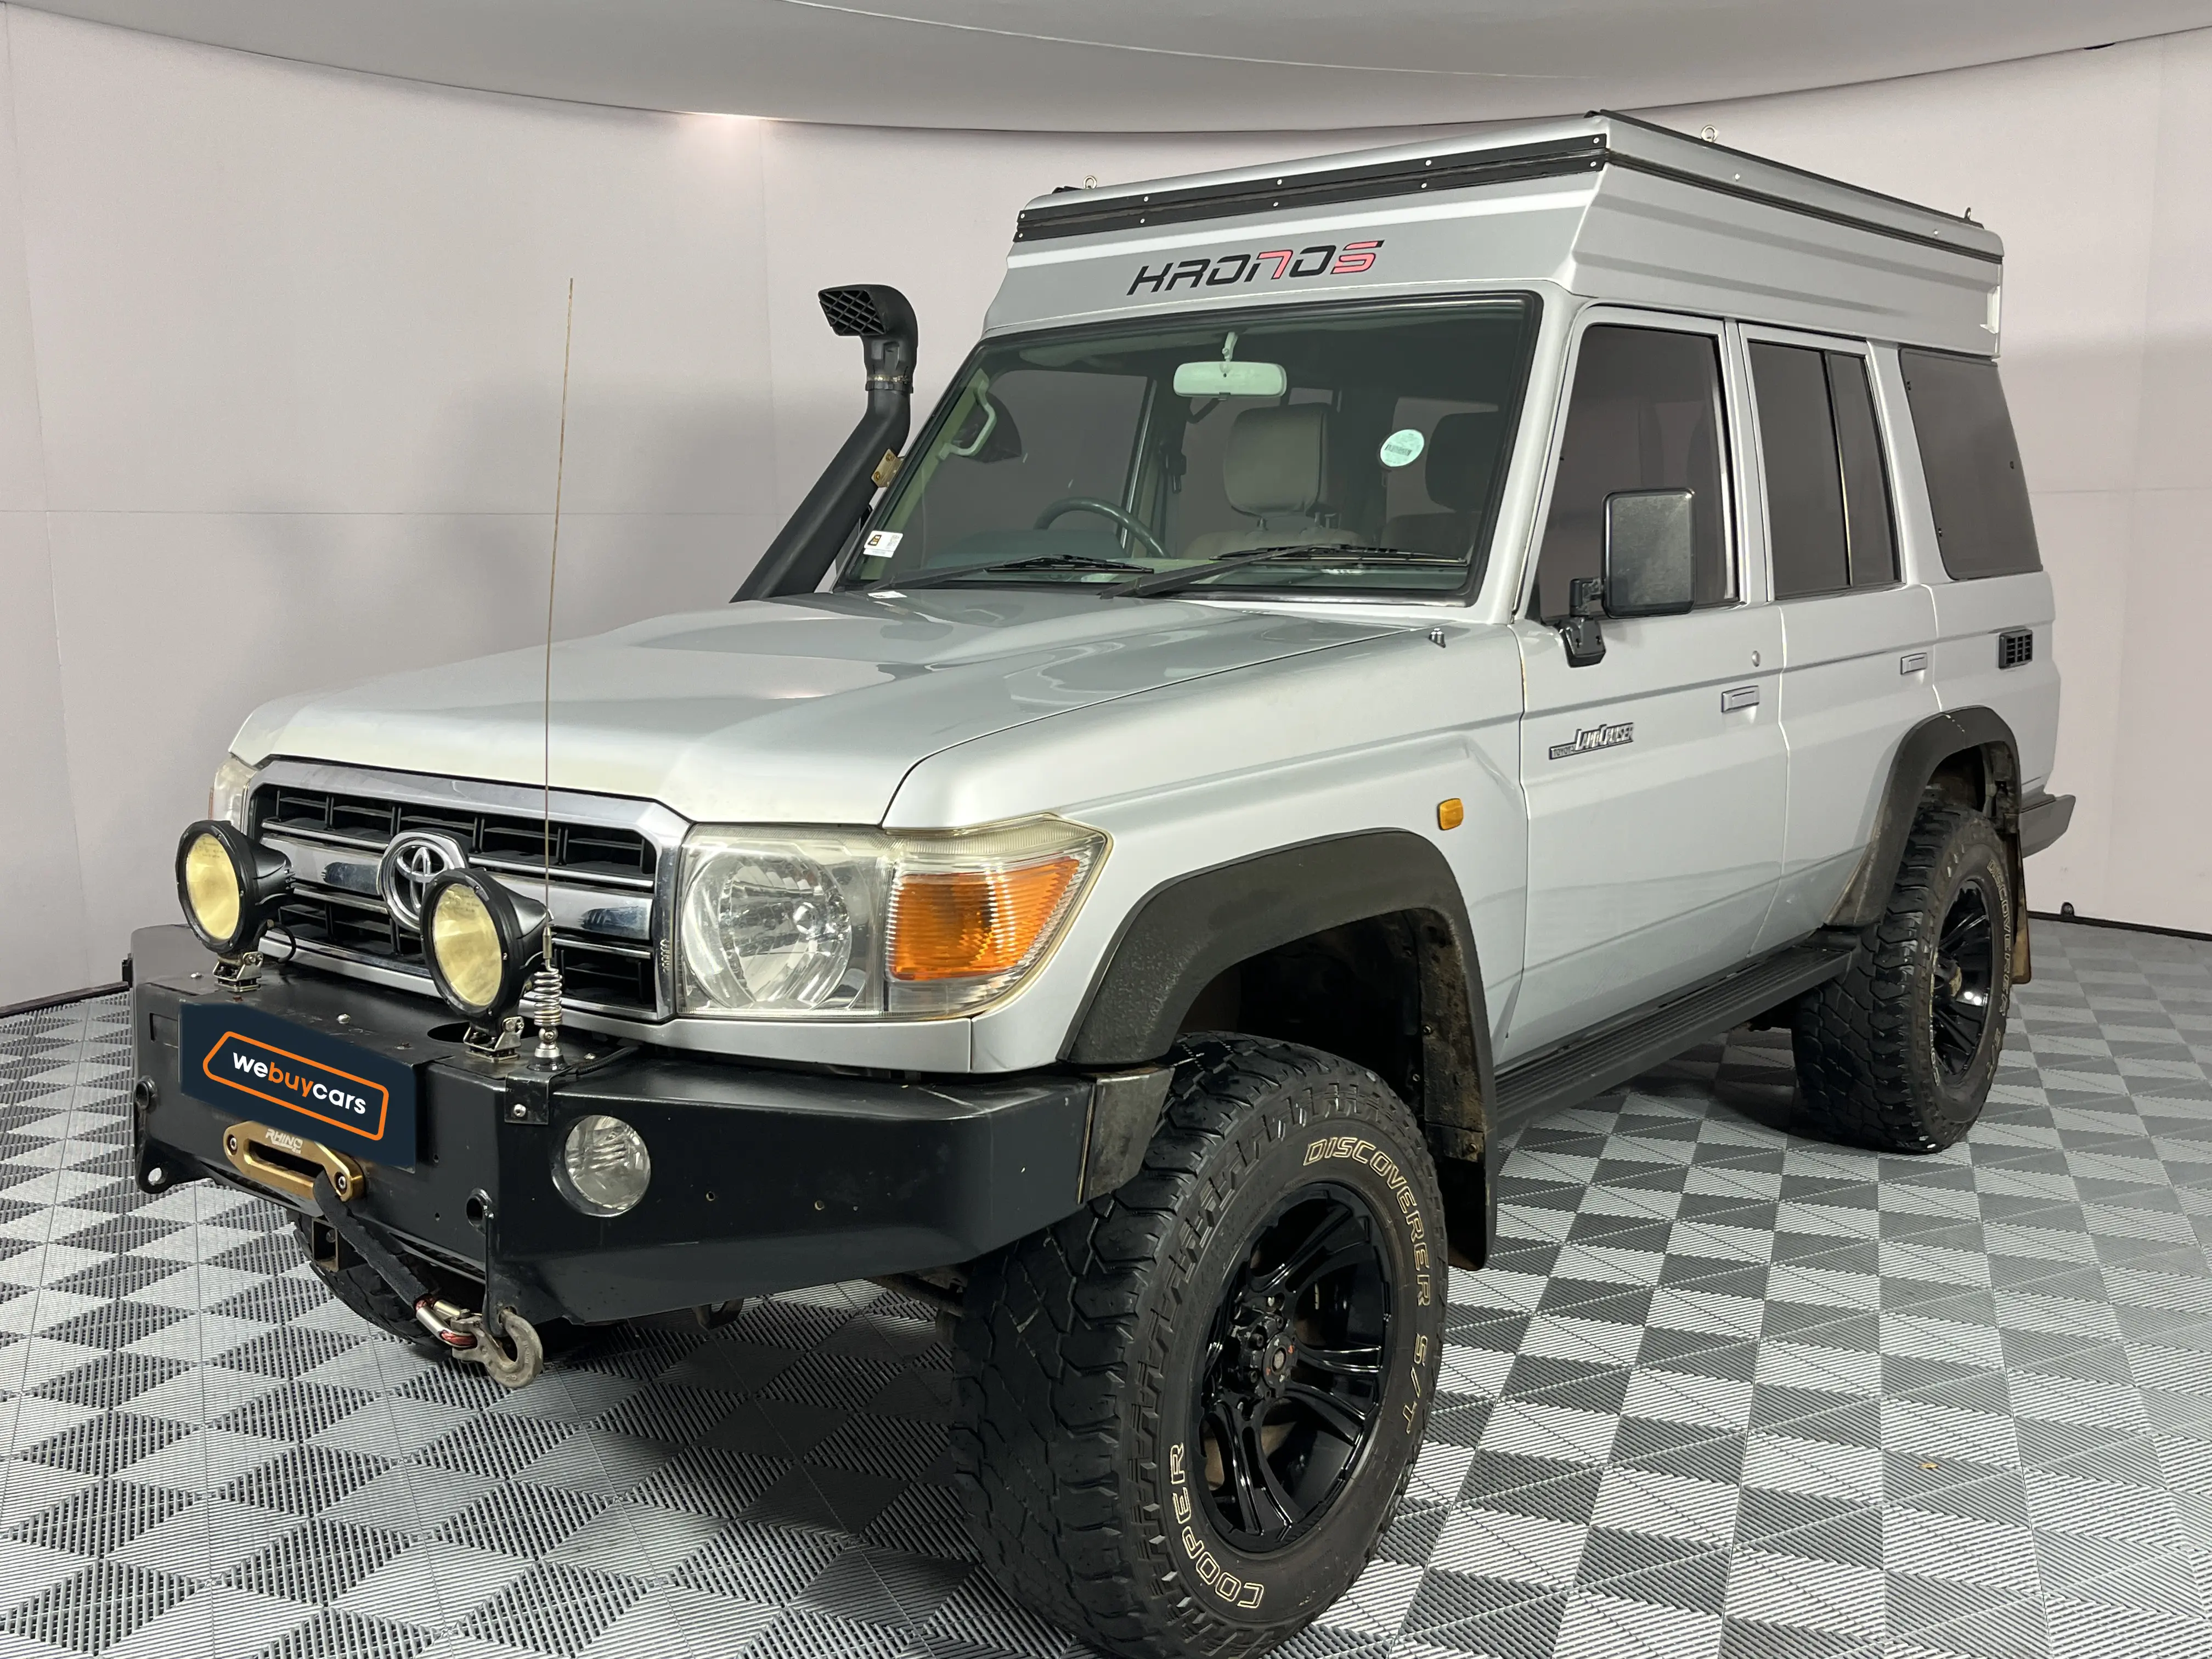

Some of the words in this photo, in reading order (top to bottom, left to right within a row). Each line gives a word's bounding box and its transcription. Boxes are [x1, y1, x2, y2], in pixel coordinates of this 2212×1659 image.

[266, 1128, 303, 1149] RHINO
[1303, 1137, 1431, 1307] DISCOVERER
[1401, 1332, 1427, 1435] S/T
[1170, 1442, 1265, 1610] COOPER
